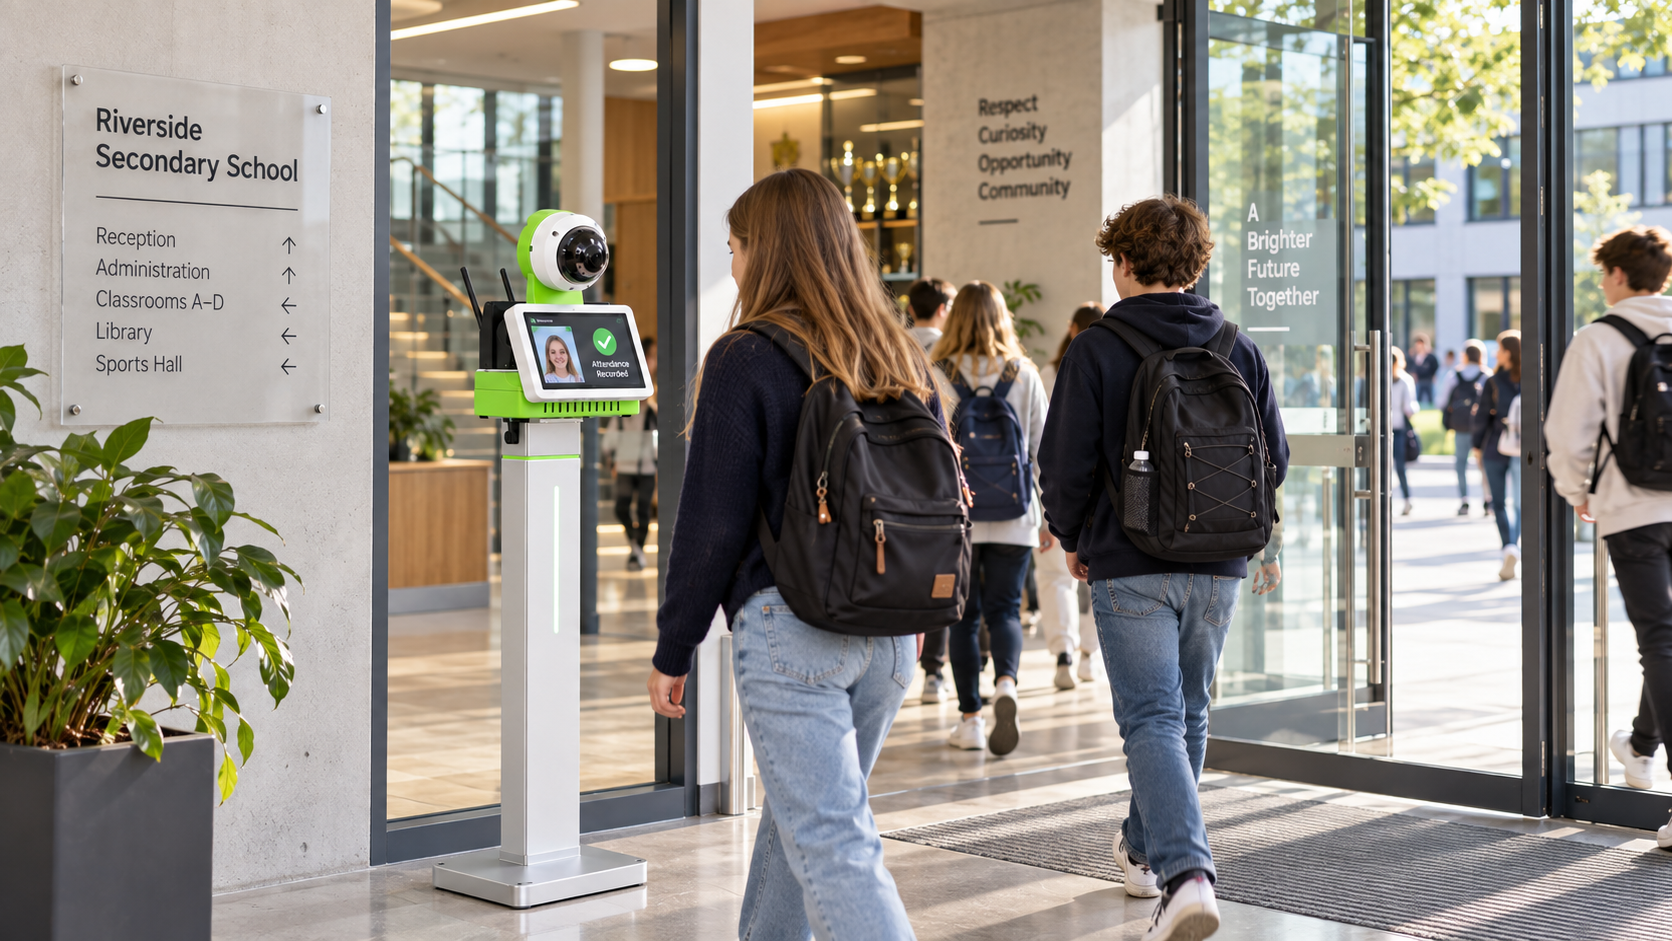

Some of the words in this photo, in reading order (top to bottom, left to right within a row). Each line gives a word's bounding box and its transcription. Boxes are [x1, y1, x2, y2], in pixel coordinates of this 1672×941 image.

[979, 94, 1038, 119] Respect
[96, 107, 203, 141] Riverside
[978, 121, 1047, 144] Curiosity
[95, 143, 220, 183] Secondary
[226, 153, 298, 182] School
[978, 148, 1072, 175] Opportunity
[978, 177, 1071, 200] Community
[1247, 202, 1259, 222] A
[96, 226, 176, 250] Reception
[1247, 229, 1313, 254] Brighter
[95, 258, 210, 280] Administration
[1248, 259, 1300, 279] Future
[96, 289, 187, 310] Classrooms
[1247, 285, 1319, 311] Together
[96, 321, 153, 345] Library
[95, 354, 149, 376] Sports
[154, 355, 182, 373] Hall
